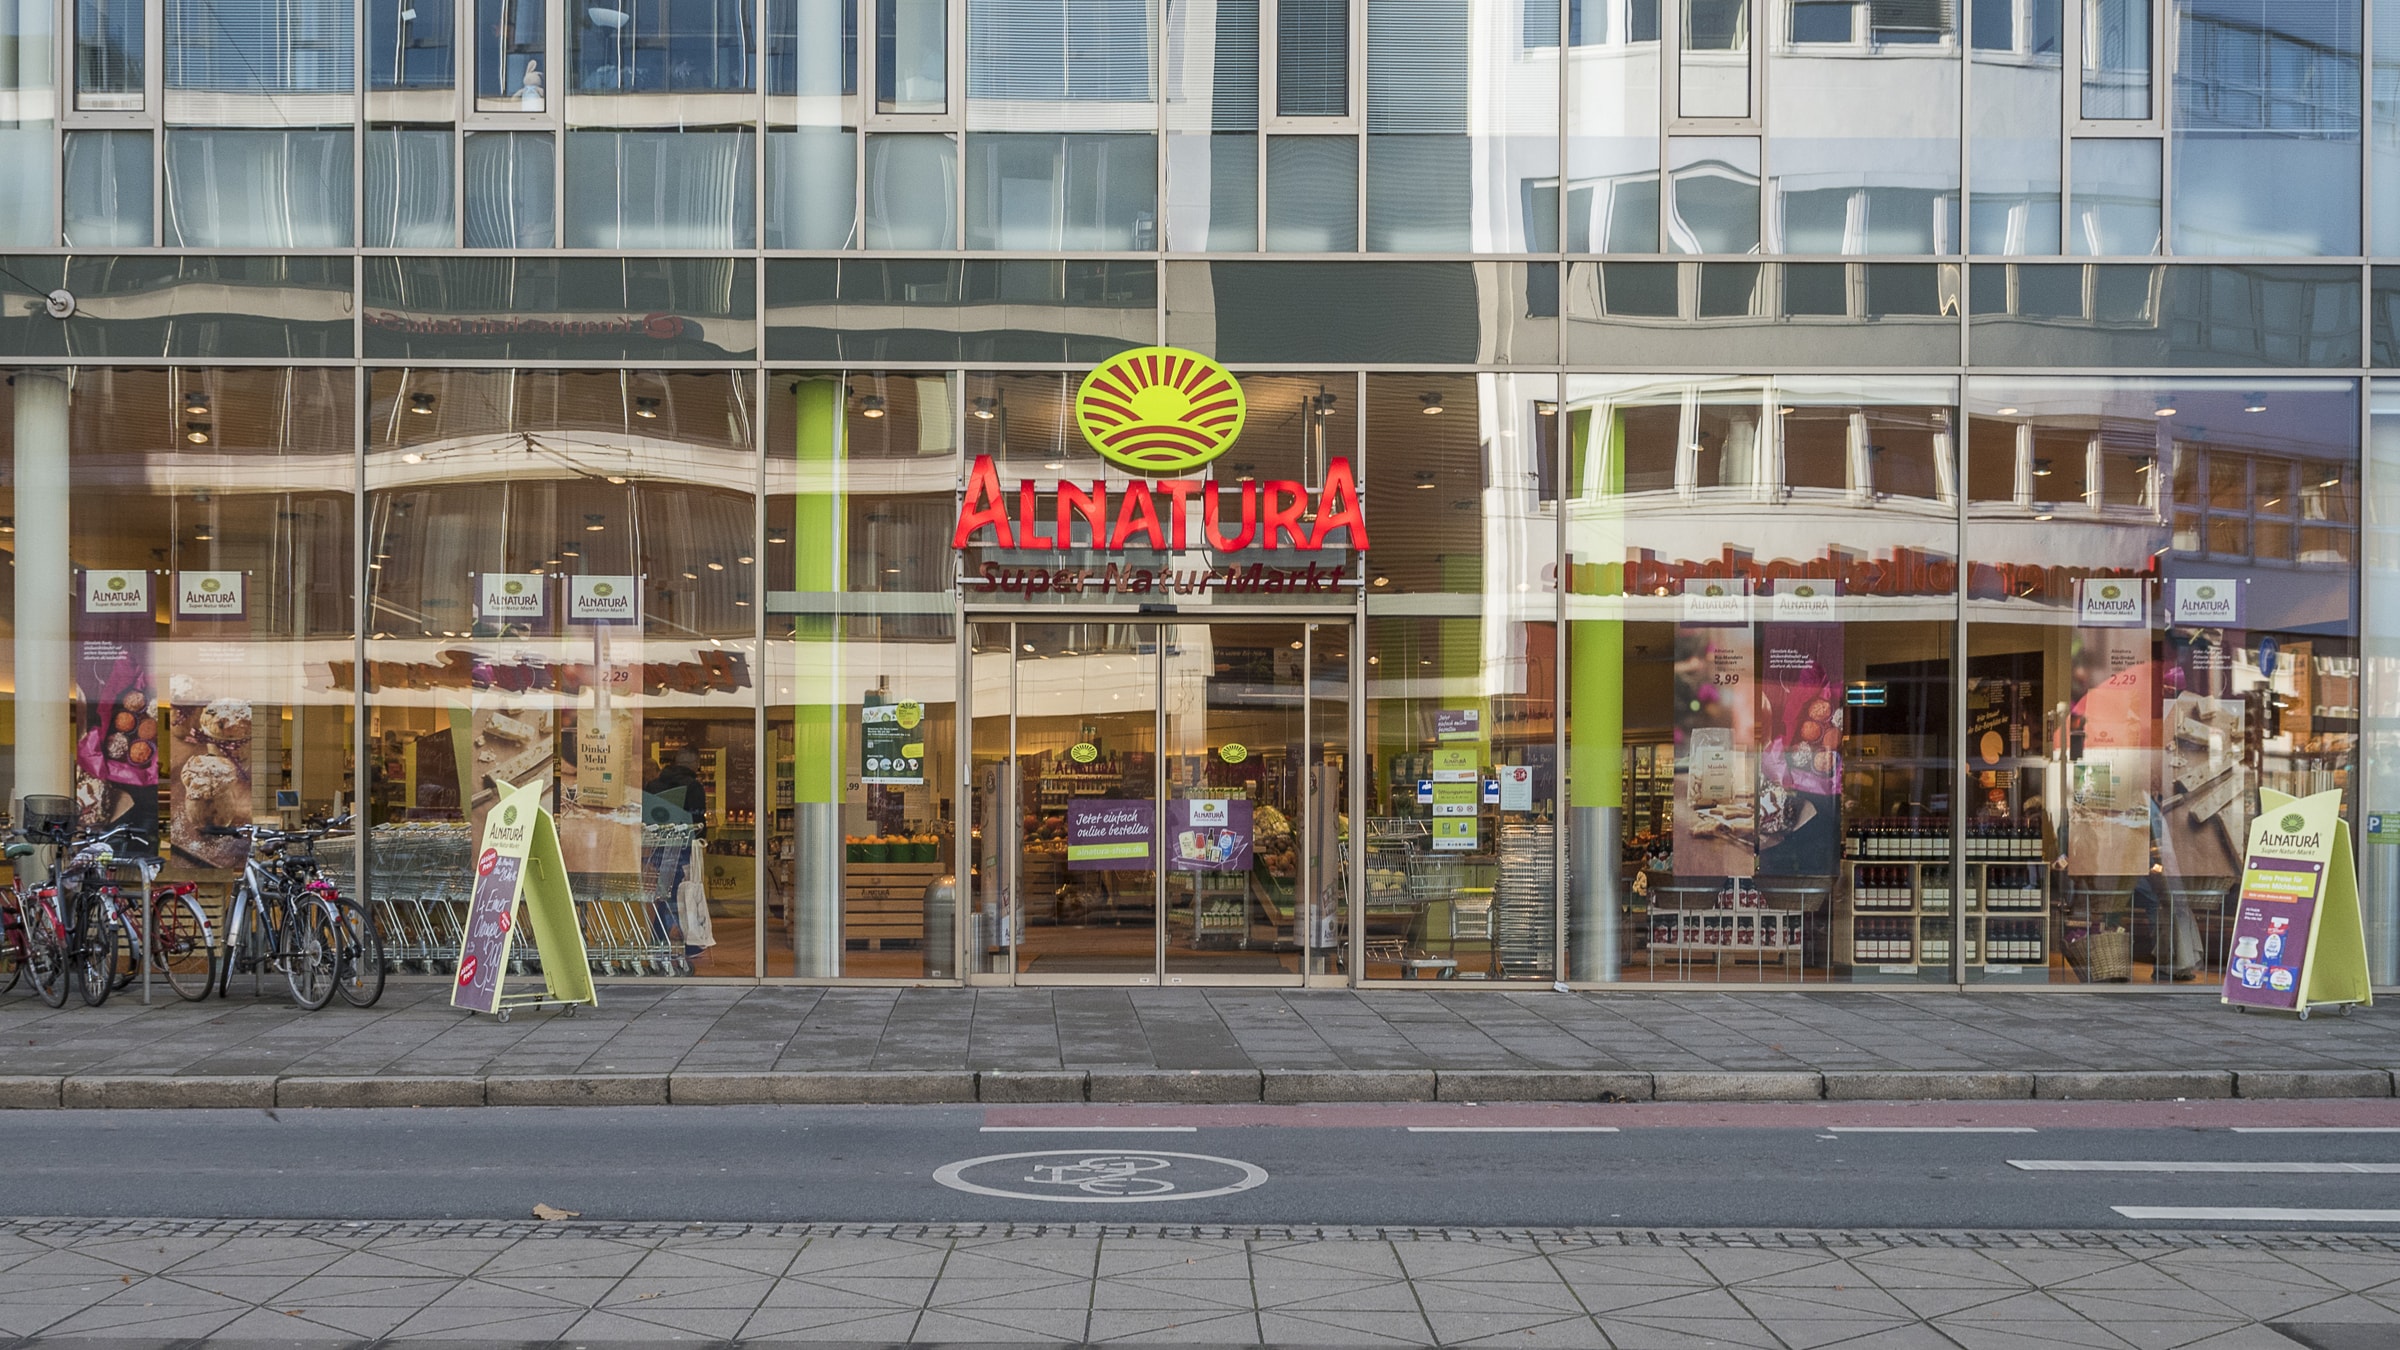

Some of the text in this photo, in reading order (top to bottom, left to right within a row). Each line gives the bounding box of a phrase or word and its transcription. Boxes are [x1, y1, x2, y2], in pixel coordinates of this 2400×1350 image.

[951, 454, 1370, 552] ALNATURA
[975, 560, 1346, 600] Super Natur Markt
[92, 590, 141, 601] ALNATURA
[186, 591, 236, 603] ALNATURA
[489, 593, 538, 606] ALNATURA
[578, 595, 628, 608] ALNATURA
[1690, 599, 1738, 610] ALNATURA
[1780, 598, 1829, 610] ALNATURA
[2087, 598, 2136, 611] ALNATURA
[2181, 598, 2230, 611] ALNATURA
[602, 671, 628, 682] 2,29
[1713, 673, 1740, 685] 3,99
[2109, 674, 2137, 686] 2,29
[581, 743, 611, 754] Dinkel
[584, 754, 607, 764] Mehl
[1076, 808, 1138, 826] Jetzt einfach
[1193, 811, 1225, 819] ALNATURA
[1077, 823, 1149, 837] online bestellen
[2369, 817, 2380, 831] P
[489, 822, 524, 841] ALNATURA
[2259, 830, 2320, 848] ALNATURA
[1077, 844, 1144, 856] alnatura-shop.de
[2274, 874, 2292, 882] Preise
[2293, 875, 2304, 883] für
